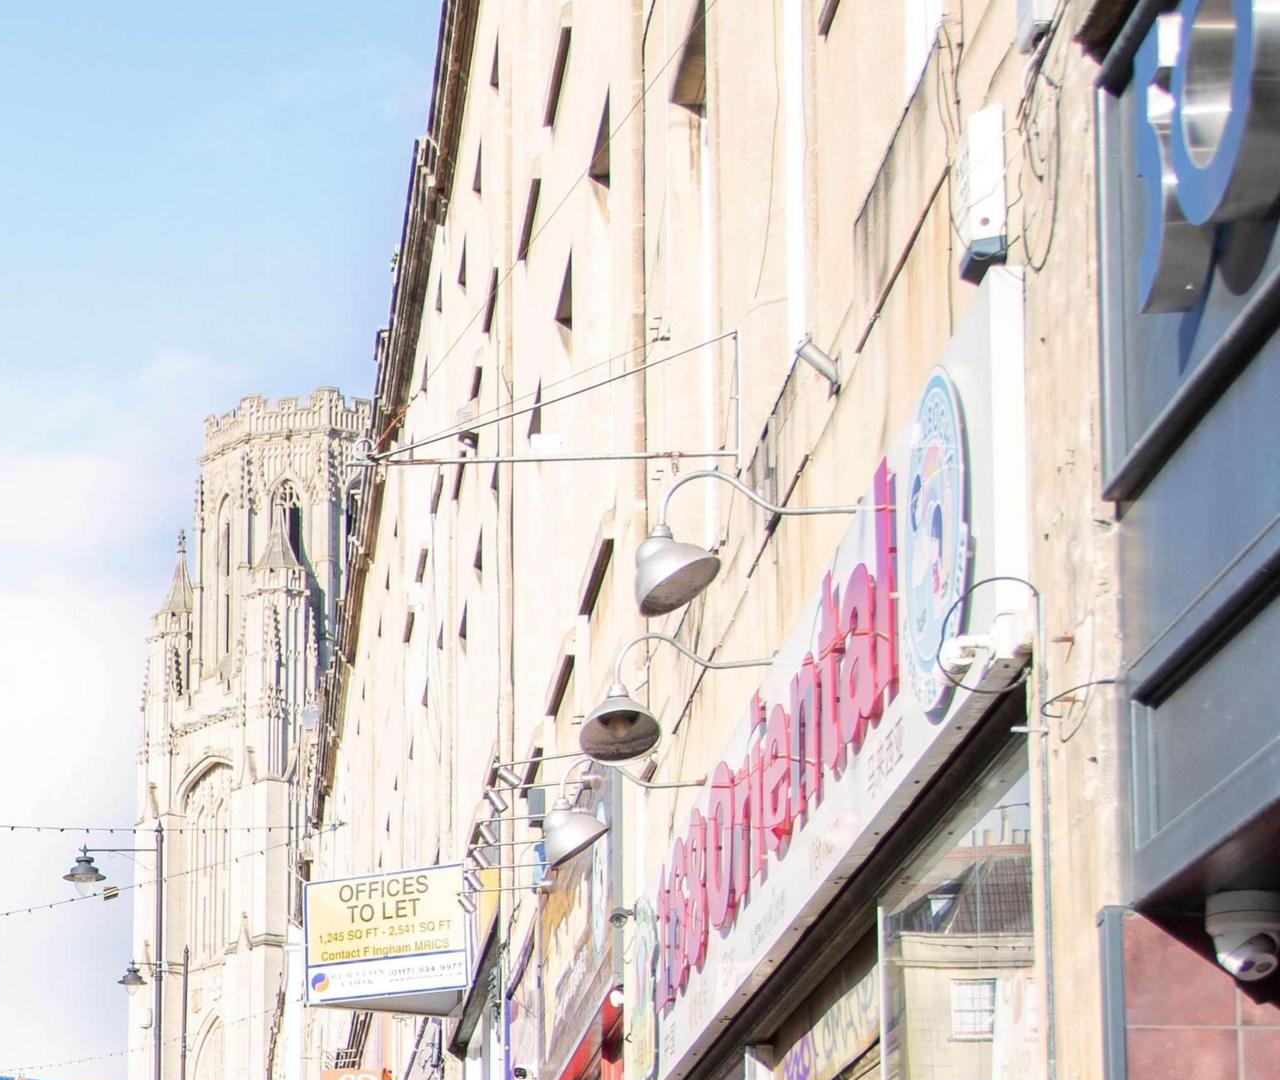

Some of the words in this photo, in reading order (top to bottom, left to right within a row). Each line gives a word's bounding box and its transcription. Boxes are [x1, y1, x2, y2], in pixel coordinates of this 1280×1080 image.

[339, 875, 429, 903] OFFICES
[347, 903, 374, 923] TO
[383, 898, 421, 920] LET
[319, 931, 344, 944] 1,245
[347, 930, 362, 941] SQ
[366, 928, 378, 939] FT
[389, 923, 415, 936] 2,541
[419, 920, 435, 932] SQ
[439, 919, 452, 930] FT
[321, 948, 360, 962] Contact
[363, 947, 370, 956] F
[373, 944, 412, 959] Ingham
[414, 938, 450, 952] MRICS
